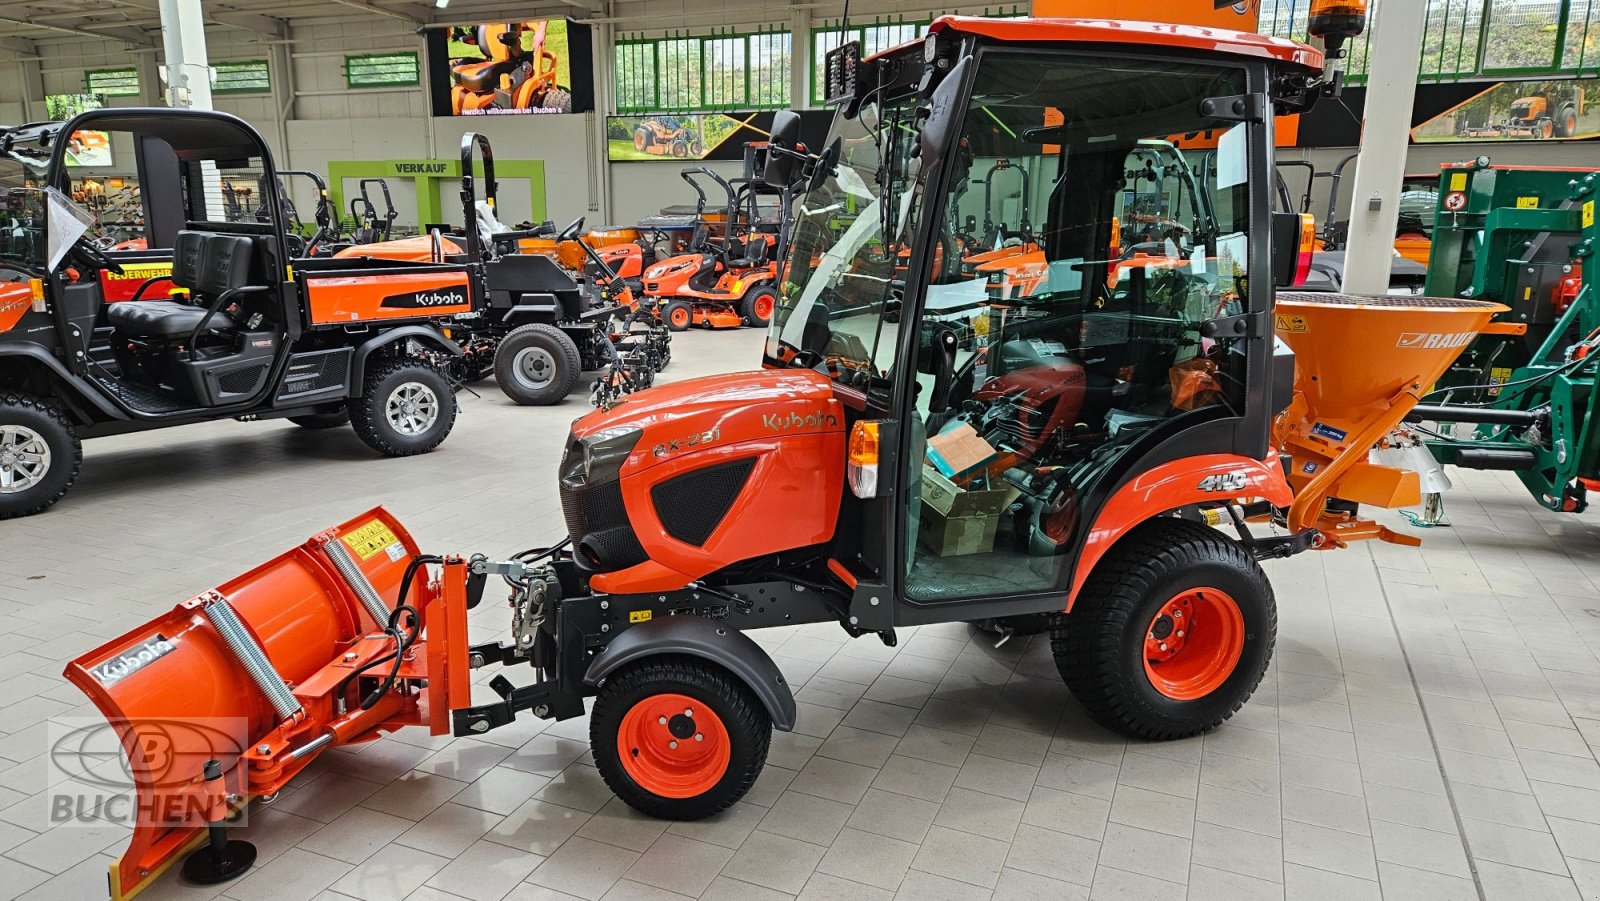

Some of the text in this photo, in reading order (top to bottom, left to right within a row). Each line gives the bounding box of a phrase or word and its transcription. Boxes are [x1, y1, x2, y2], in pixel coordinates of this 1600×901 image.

[487, 107, 521, 115] willkommen
[522, 106, 531, 114] bei
[395, 163, 447, 173] VERKAUF
[415, 291, 464, 306] Kubota
[1422, 330, 1479, 349] RAUCH
[762, 410, 837, 432] Kubota
[653, 428, 721, 458] BX-231
[1197, 473, 1248, 492] 4WD
[92, 640, 173, 681] Kubota
